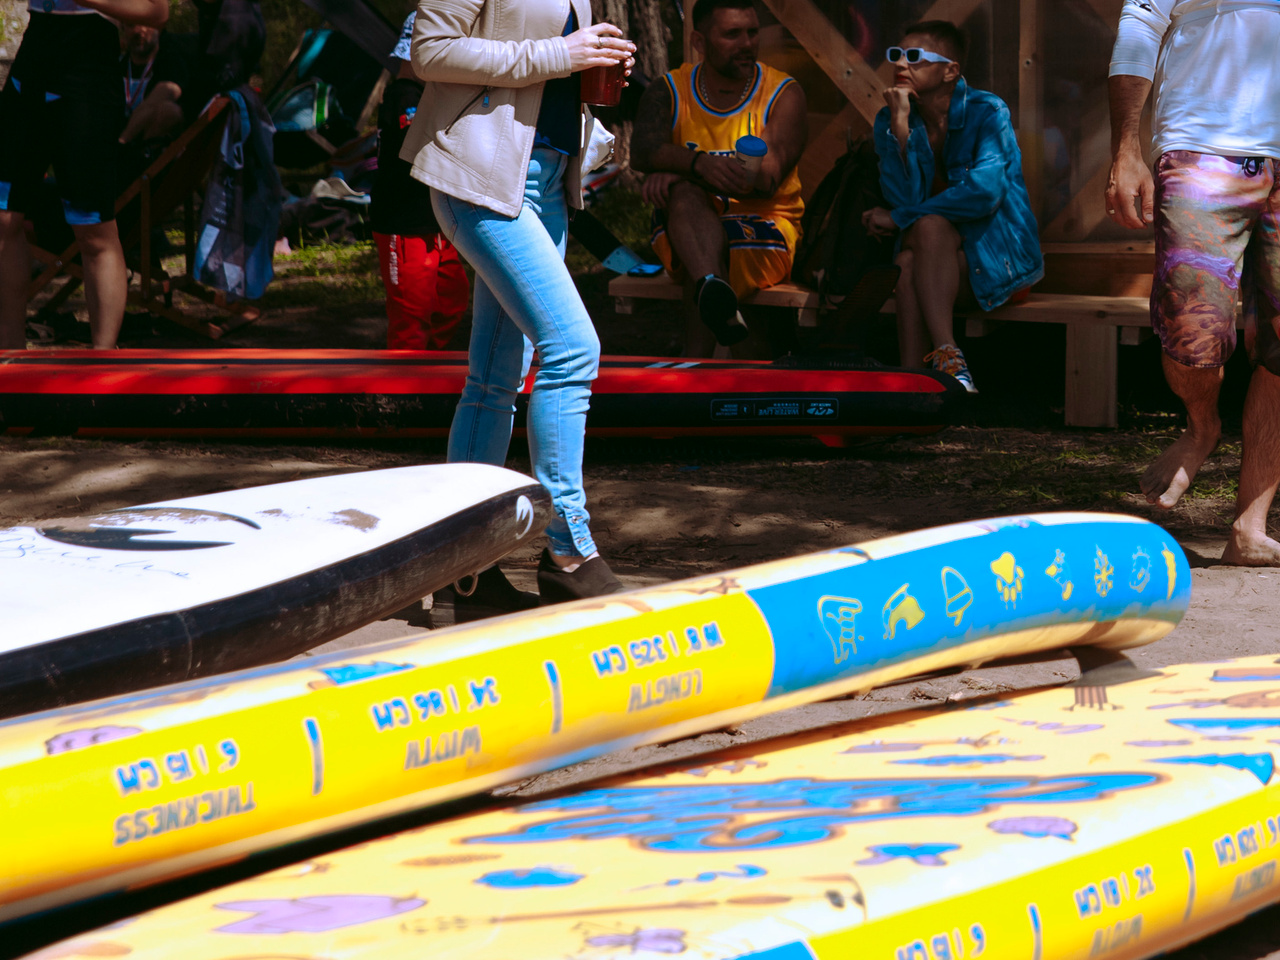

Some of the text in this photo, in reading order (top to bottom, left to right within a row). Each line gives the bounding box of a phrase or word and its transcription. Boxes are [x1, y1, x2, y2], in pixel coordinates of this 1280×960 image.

[592, 646, 627, 678] CM
[630, 637, 667, 667] 325
[414, 691, 445, 720] 86
[627, 670, 703, 714] LENGTH
[372, 699, 410, 732] CM
[404, 726, 482, 771] WIDTH
[116, 760, 159, 798] CM
[113, 781, 256, 848] THICKNESS
[1213, 836, 1237, 867] CM
[1075, 885, 1102, 919] CM
